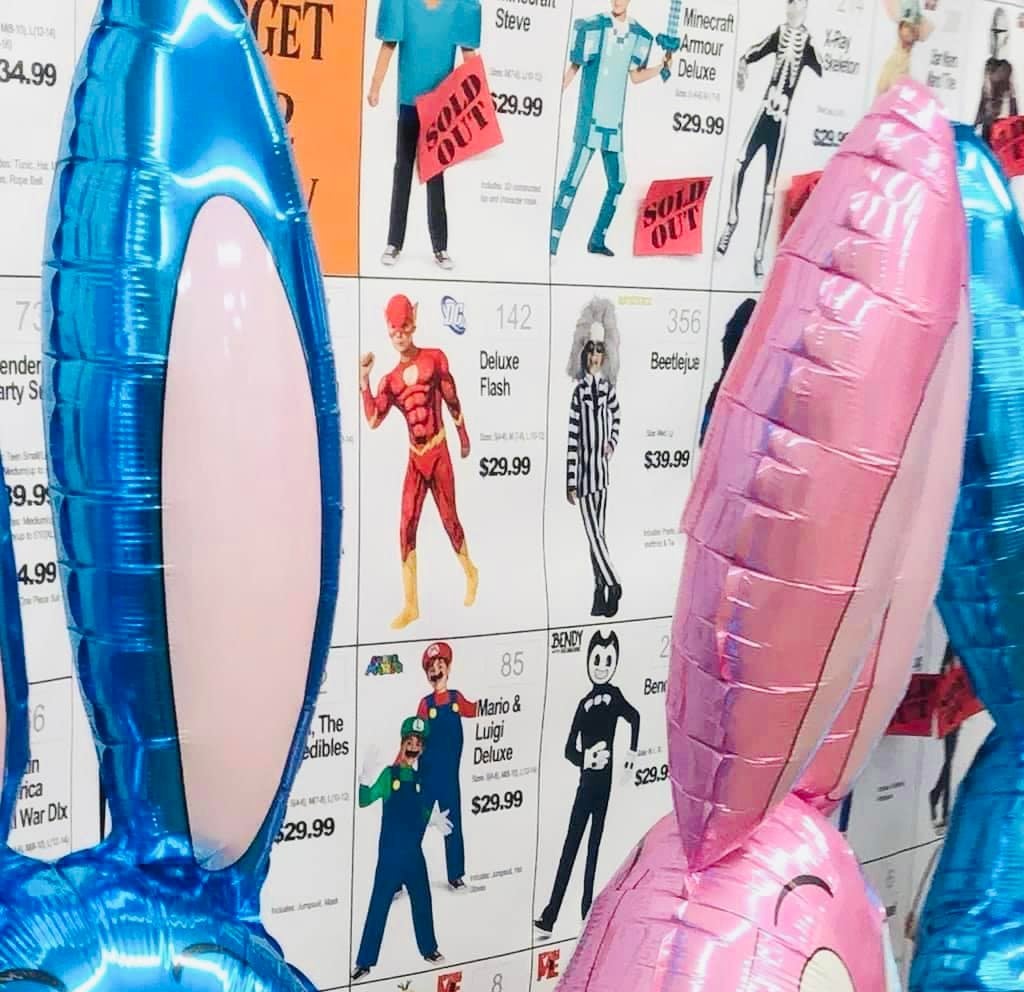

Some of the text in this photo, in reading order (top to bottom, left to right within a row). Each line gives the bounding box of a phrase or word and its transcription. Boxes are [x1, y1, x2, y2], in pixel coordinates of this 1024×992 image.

[495, 8, 531, 32] Steve
[683, 7, 734, 33] Minecraft
[680, 34, 724, 56] Armour
[677, 58, 717, 82] Deluxe
[425, 74, 481, 152] SOLD
[672, 112, 725, 135] $29.99
[437, 101, 488, 166] OUT
[643, 180, 705, 228] SOLD
[651, 206, 699, 249] OUT
[497, 303, 533, 331] 142
[667, 308, 701, 334] 356
[479, 350, 520, 370] Deluxe
[480, 376, 511, 397] Flash
[479, 456, 531, 478] $29.99
[644, 450, 690, 470] $39.99
[551, 630, 583, 649] BENDY
[500, 651, 524, 678] 85
[477, 694, 522, 718] Mario &
[318, 714, 344, 734] The
[475, 720, 505, 744] Luigi
[474, 746, 513, 766] Deluxe
[20, 807, 45, 828] War
[48, 801, 68, 822] Dlx
[471, 790, 524, 816] $29.99
